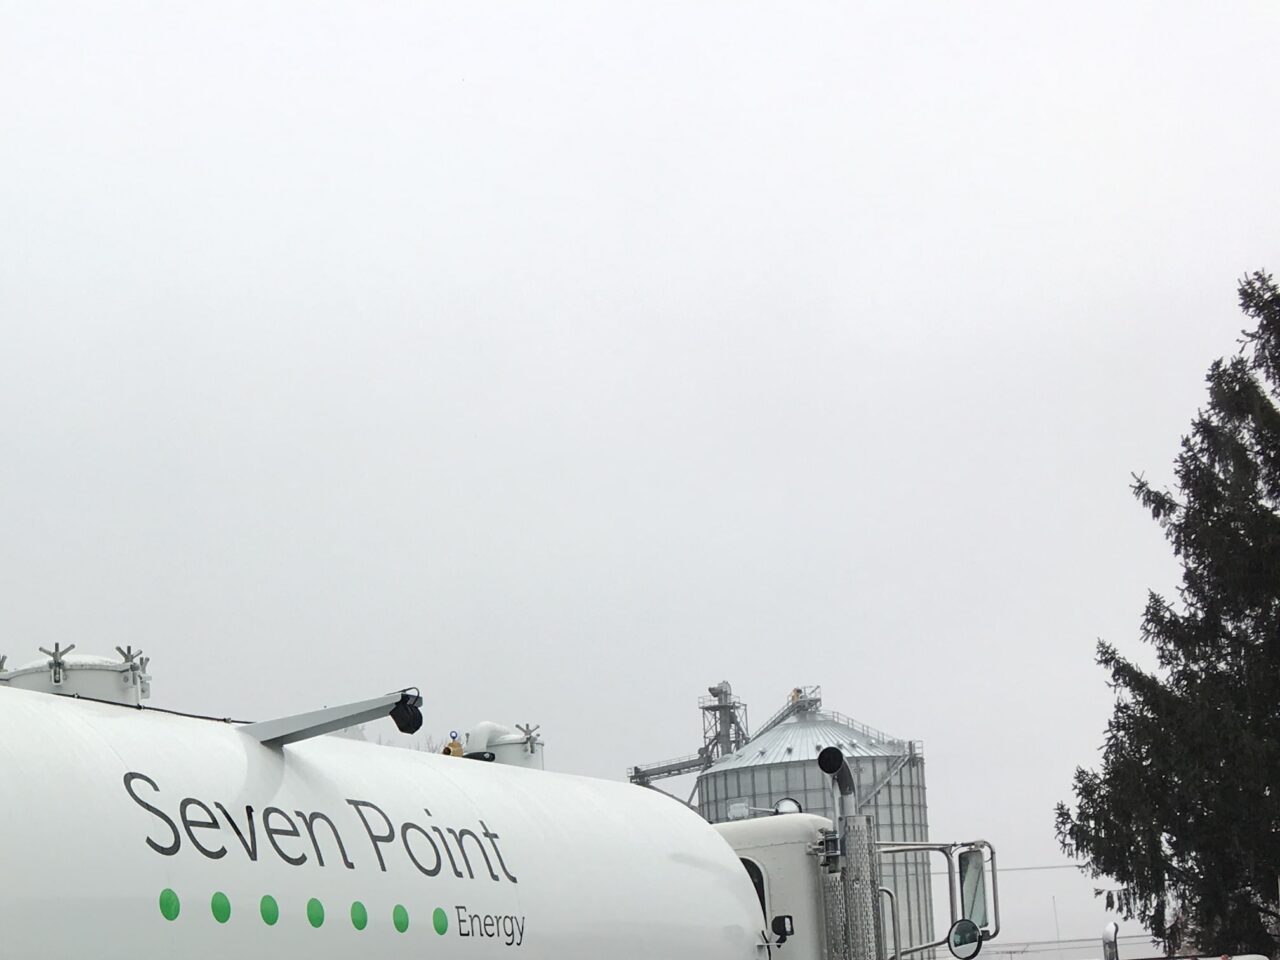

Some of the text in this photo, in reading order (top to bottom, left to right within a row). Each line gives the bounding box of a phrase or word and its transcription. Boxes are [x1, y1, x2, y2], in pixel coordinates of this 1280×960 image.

[122, 771, 518, 884] Seven Point
[454, 905, 526, 947] Energy
